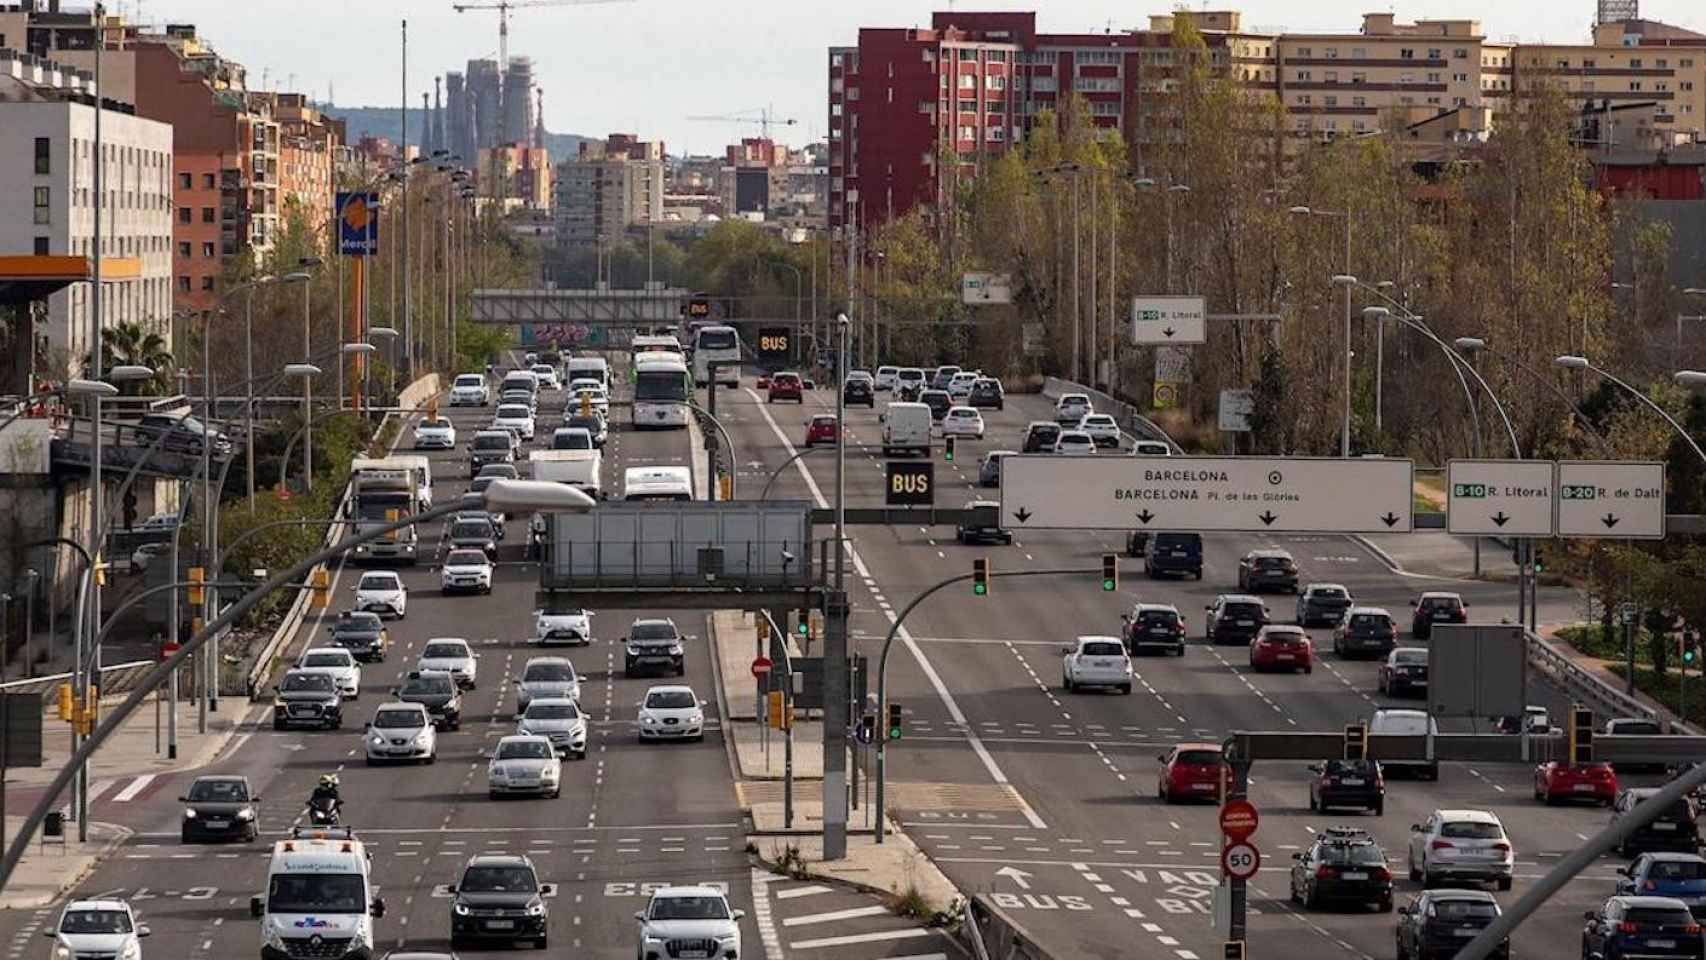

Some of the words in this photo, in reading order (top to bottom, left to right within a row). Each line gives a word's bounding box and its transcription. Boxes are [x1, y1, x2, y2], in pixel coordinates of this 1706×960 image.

[761, 336, 788, 350] BUS
[1144, 470, 1229, 482] BARCELONA
[892, 474, 928, 493] BUS
[1115, 489, 1199, 500] BARCELONA
[1225, 492, 1238, 501] de
[1455, 485, 1484, 497] B-10
[1505, 486, 1548, 497] Litoral
[1562, 487, 1593, 498] B-20
[1614, 488, 1630, 498] de
[1635, 488, 1660, 498] Dalt
[1230, 854, 1252, 867] 50
[989, 893, 1093, 910] BUS
